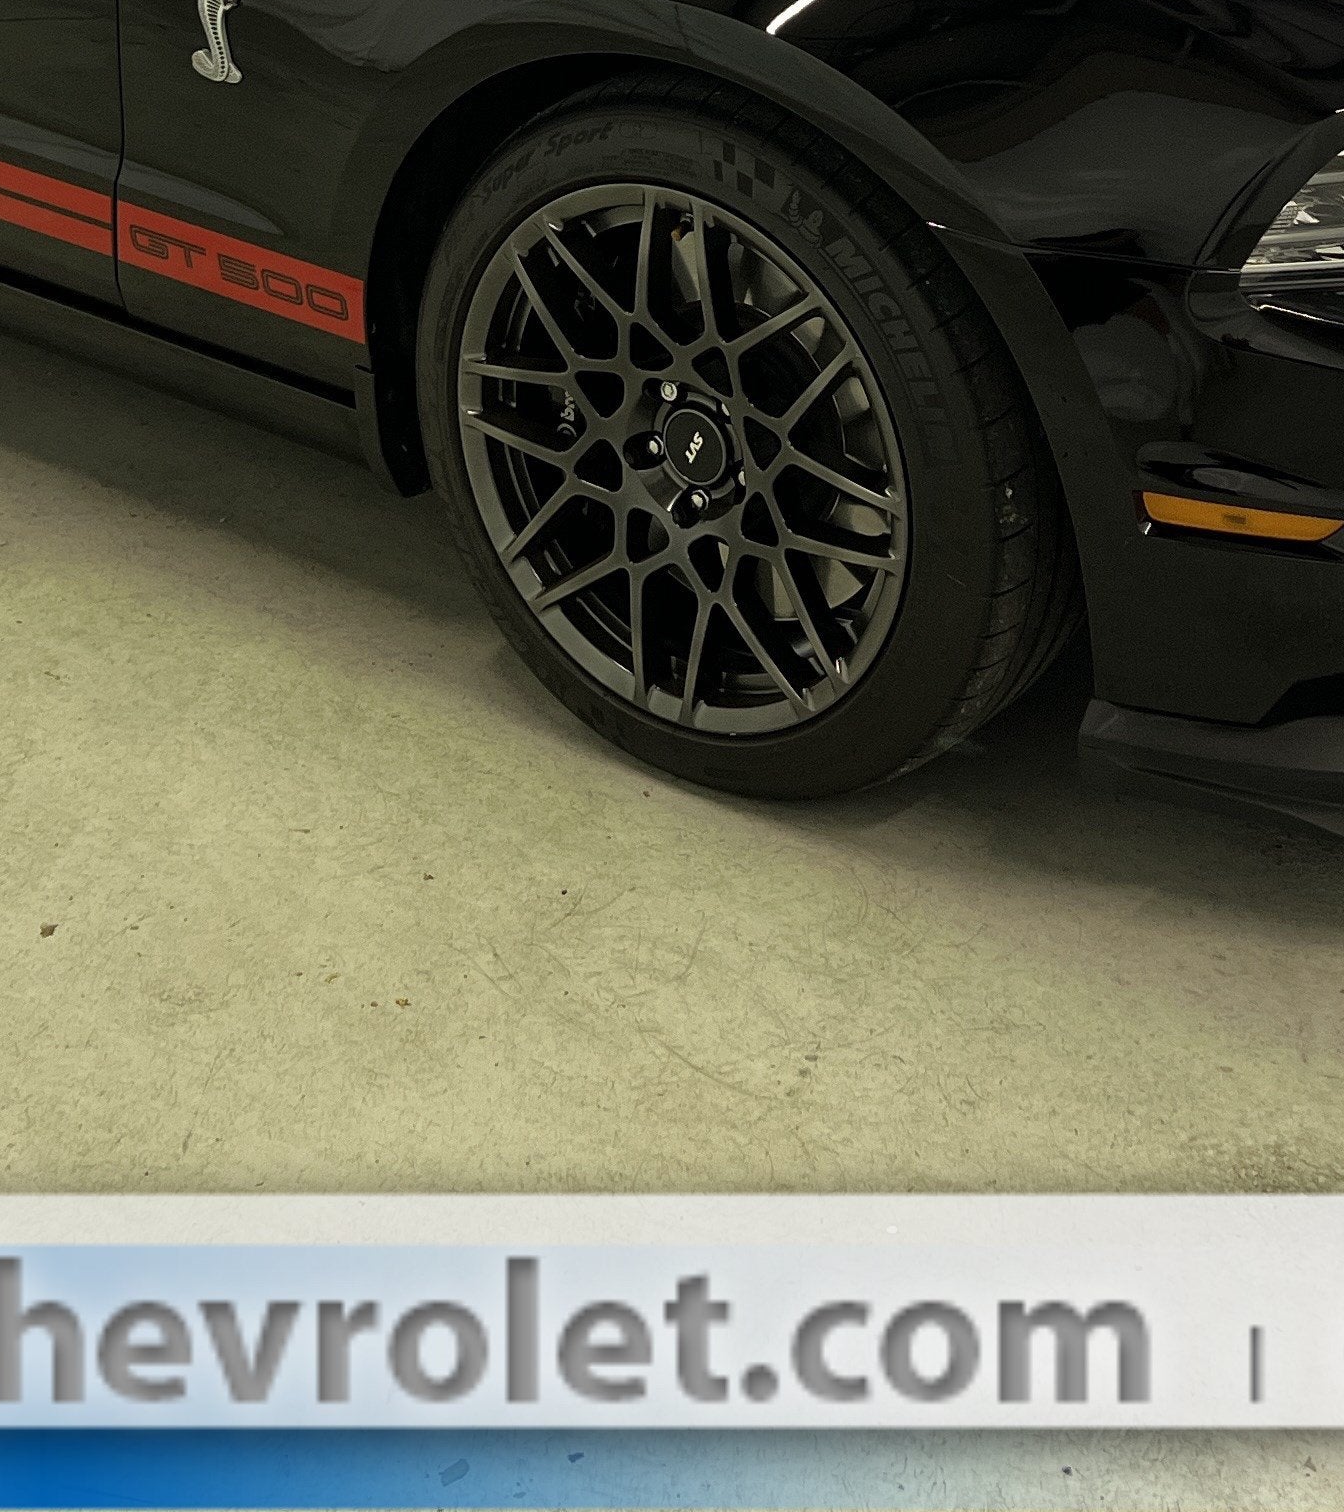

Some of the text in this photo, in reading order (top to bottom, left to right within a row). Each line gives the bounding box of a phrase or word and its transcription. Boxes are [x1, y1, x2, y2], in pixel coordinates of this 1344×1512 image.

[543, 121, 614, 157] Sport
[129, 224, 349, 322] GT 500
[685, 431, 704, 464] SVT
